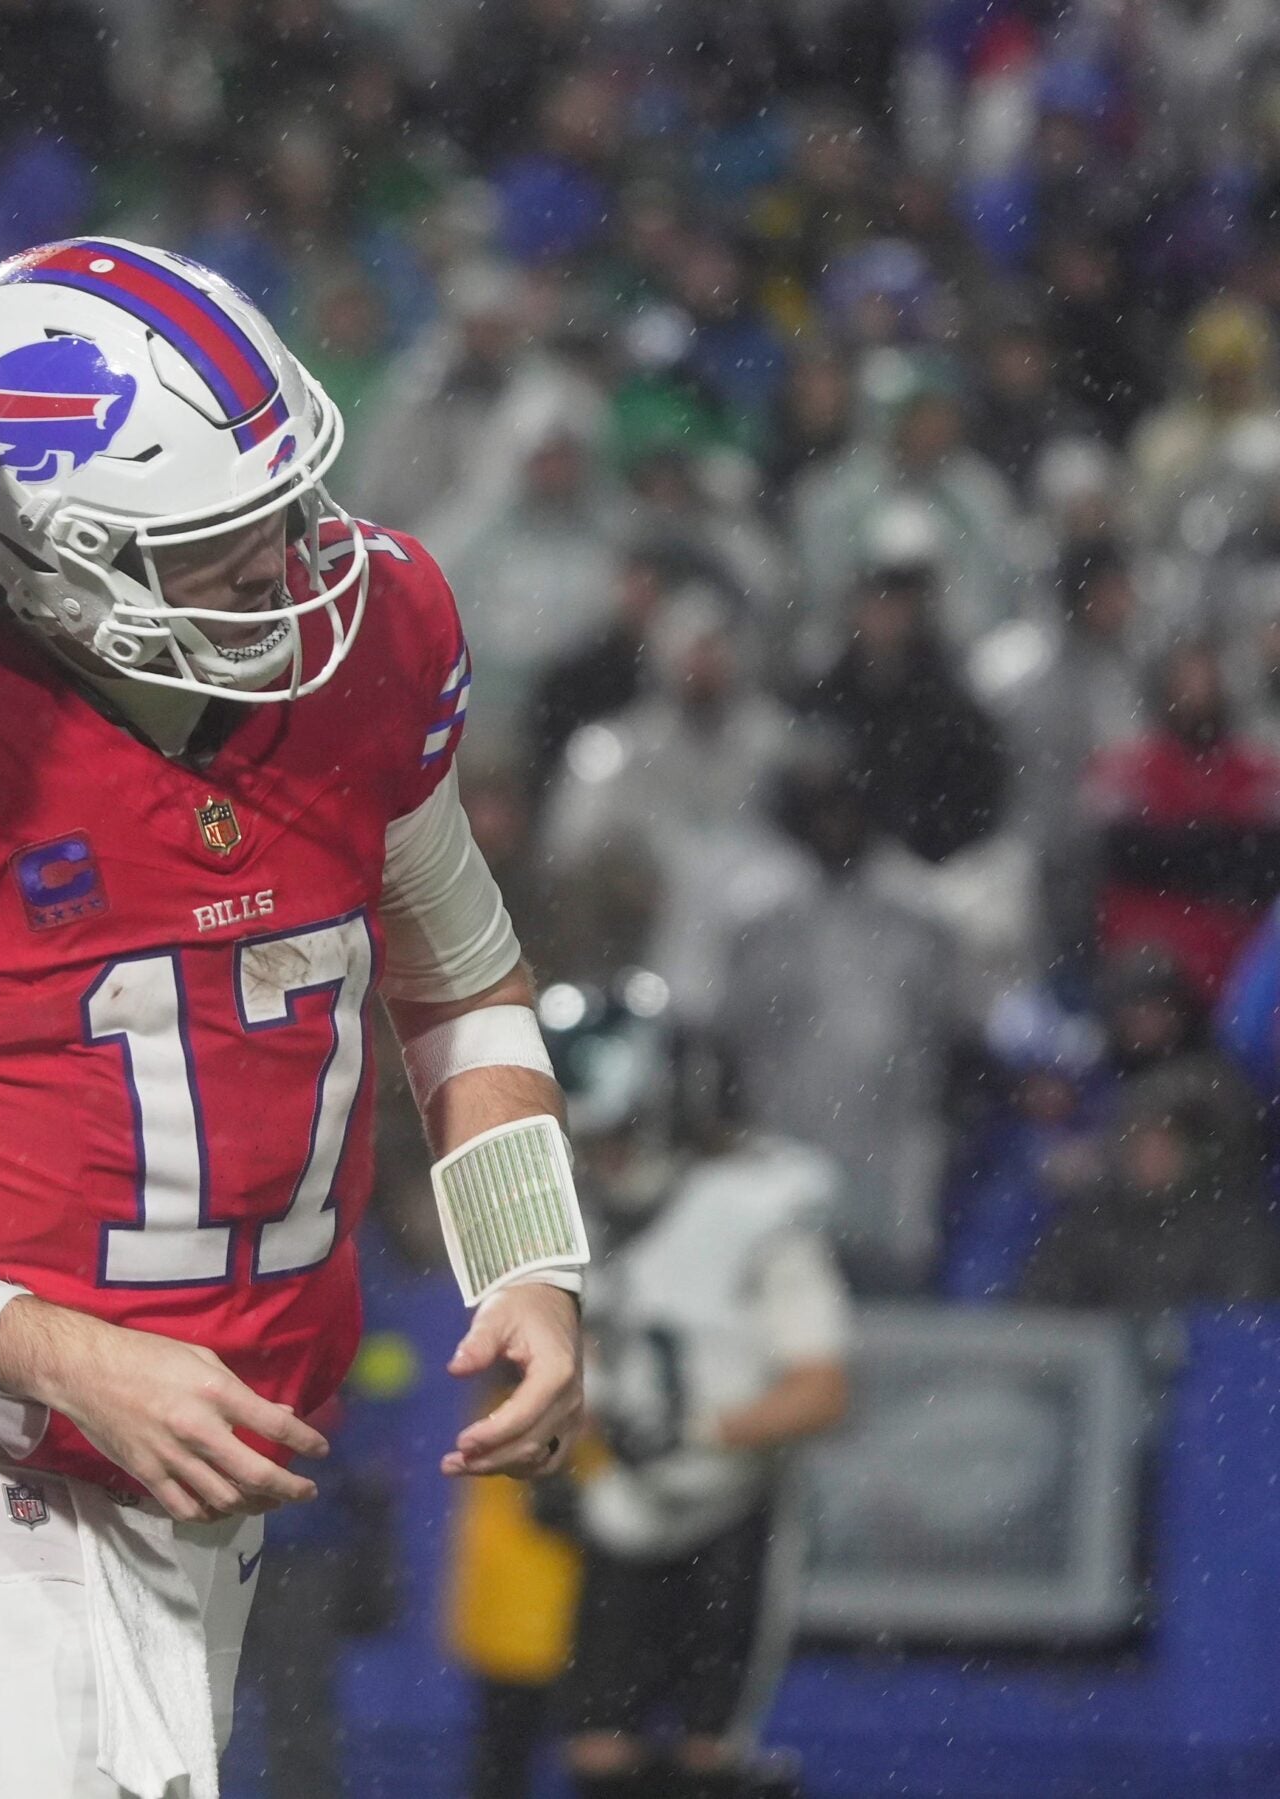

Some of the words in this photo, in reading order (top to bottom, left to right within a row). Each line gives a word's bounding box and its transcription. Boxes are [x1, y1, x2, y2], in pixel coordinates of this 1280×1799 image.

[18, 838, 95, 908] C
[192, 889, 274, 932] BILLS
[80, 904, 374, 1290] 17
[13, 1500, 44, 1520] NFL
